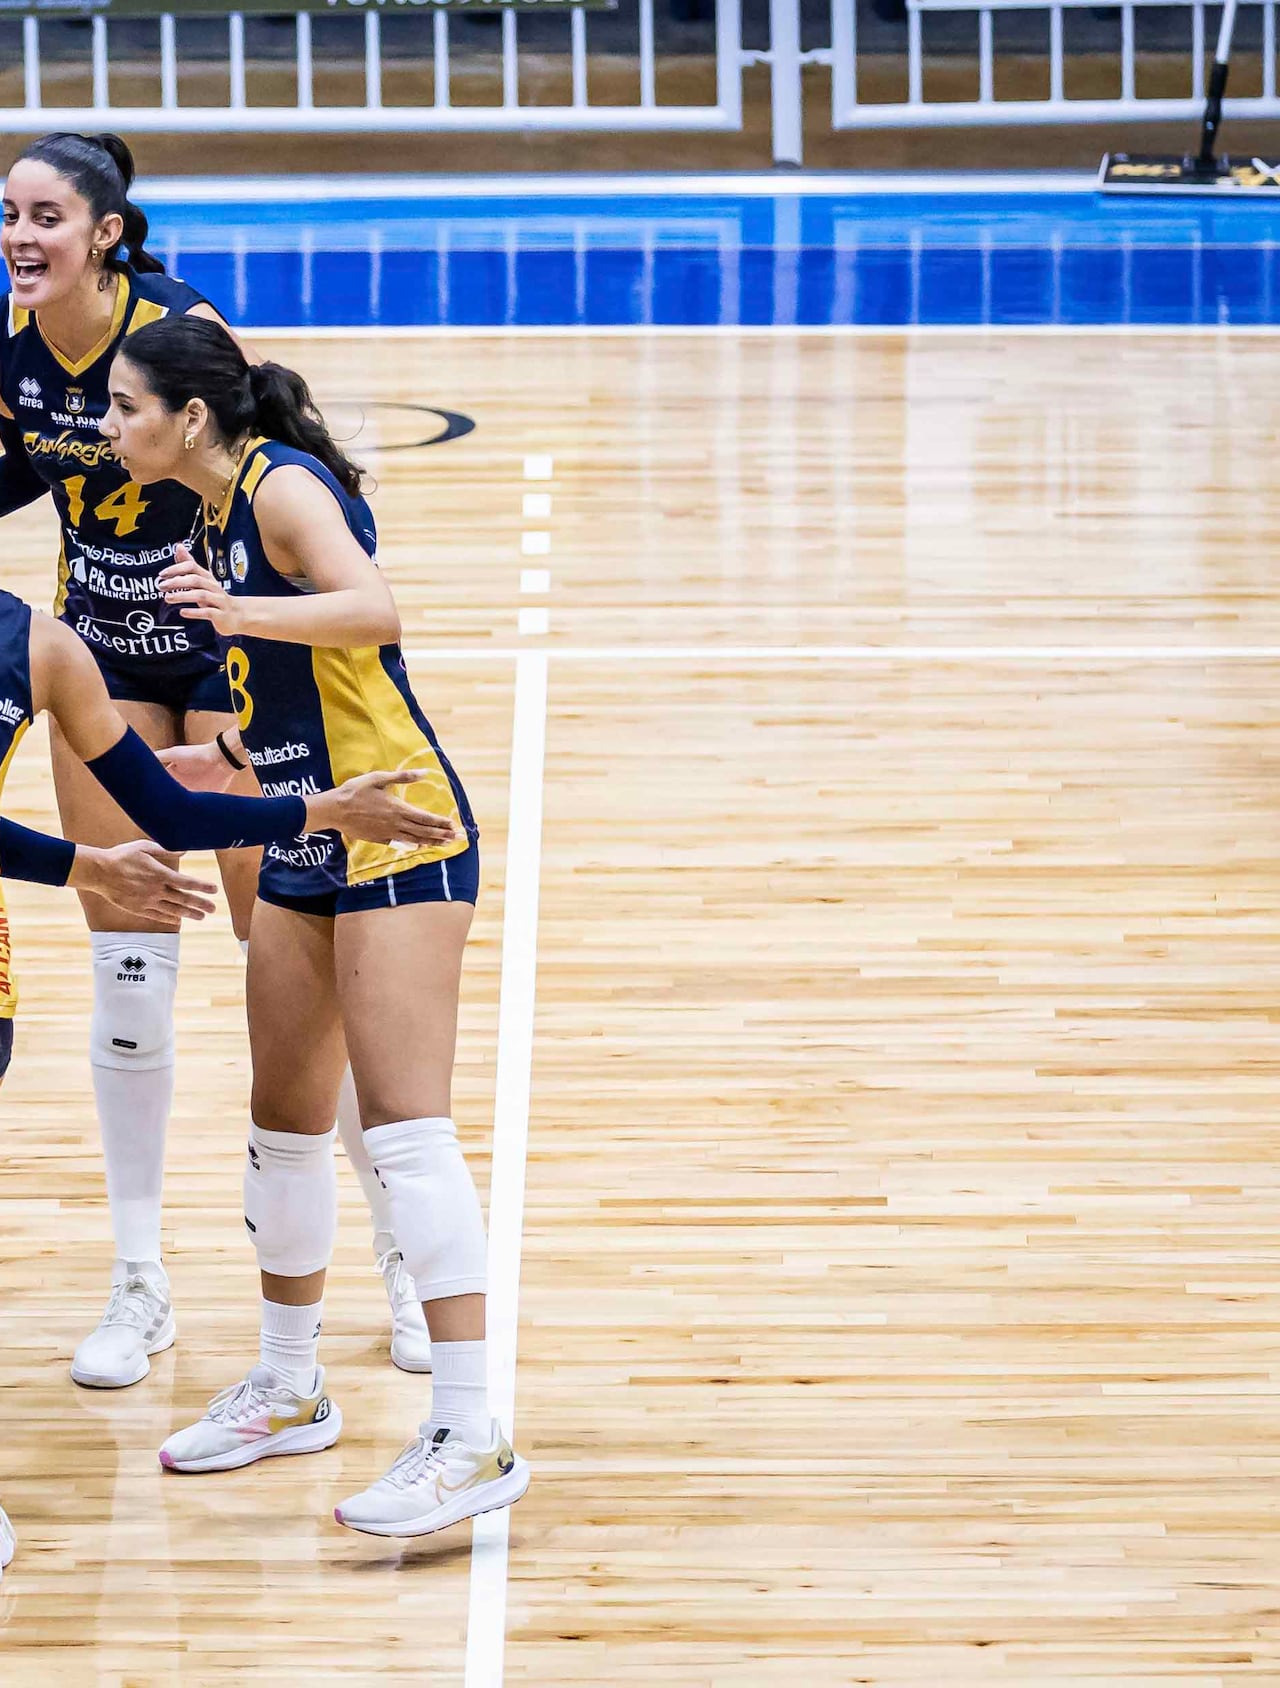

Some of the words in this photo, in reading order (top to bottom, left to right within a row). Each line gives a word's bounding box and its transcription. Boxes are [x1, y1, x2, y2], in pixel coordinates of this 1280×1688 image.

[19, 395, 43, 409] errea
[50, 411, 73, 424] SAN
[61, 474, 152, 537] 14
[88, 566, 106, 589] PR
[117, 972, 145, 982] errea
